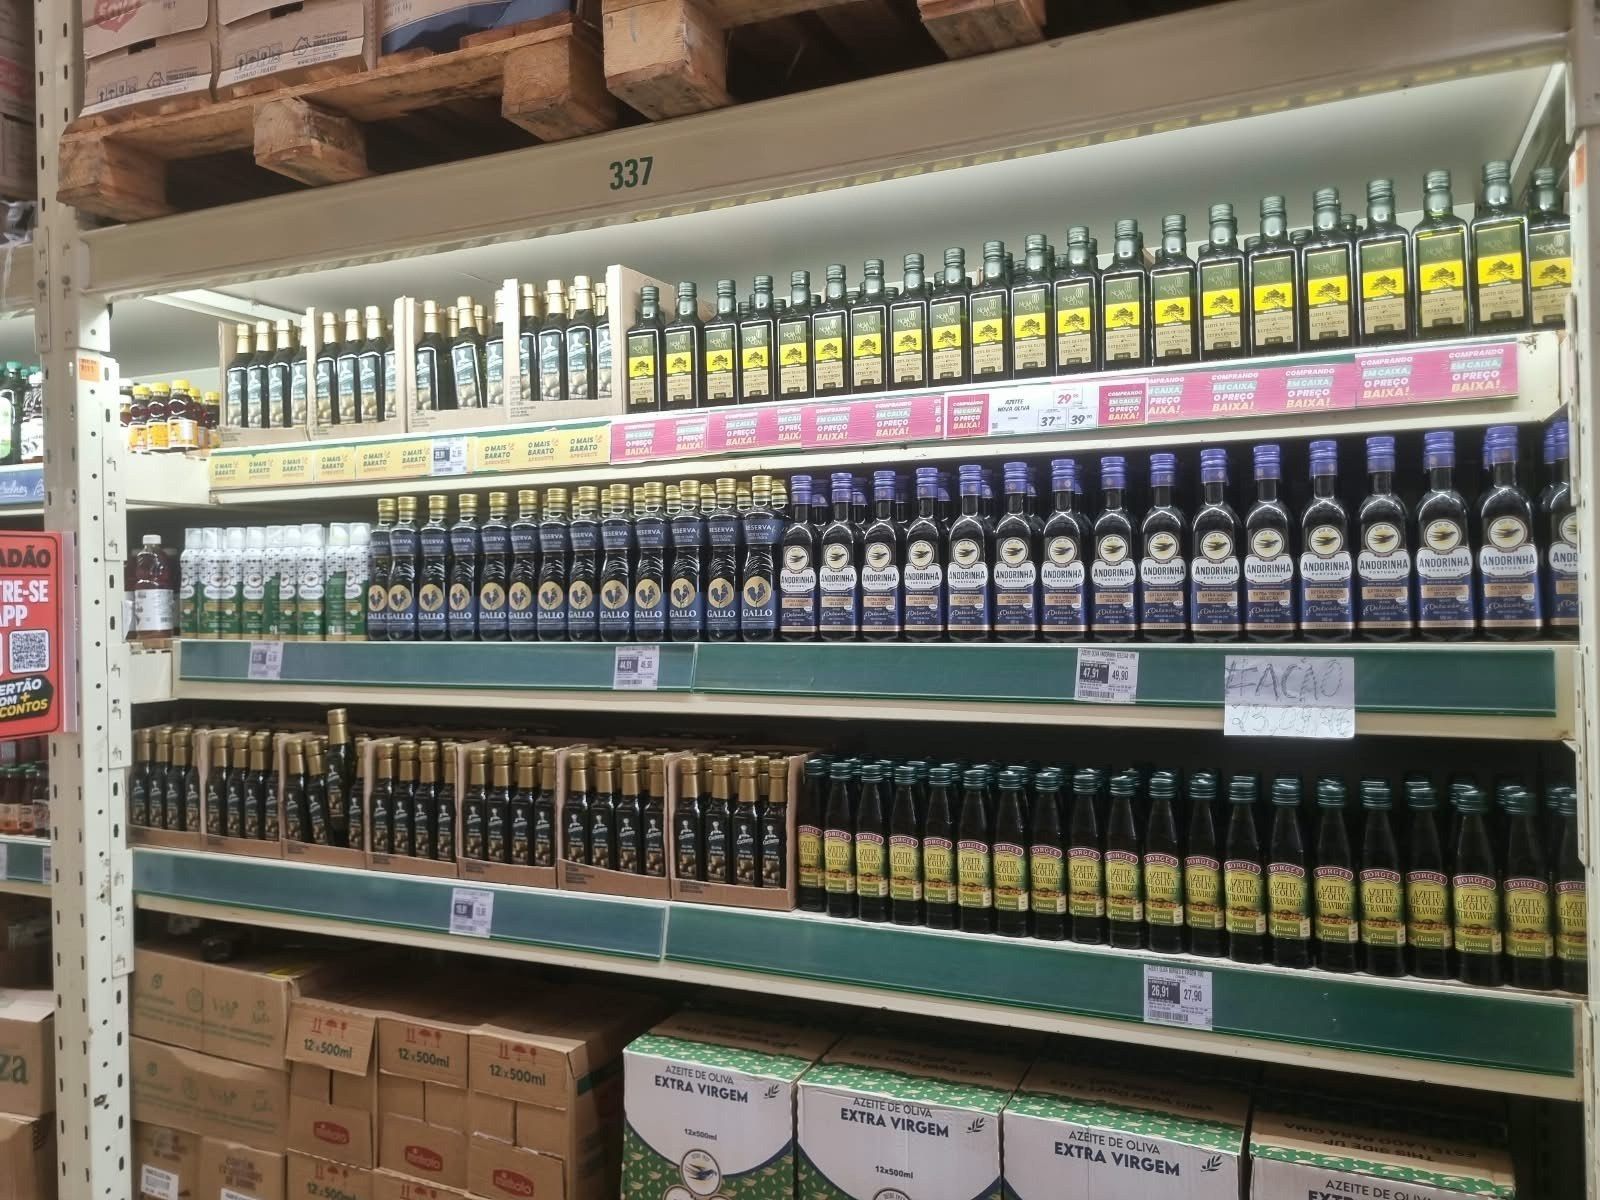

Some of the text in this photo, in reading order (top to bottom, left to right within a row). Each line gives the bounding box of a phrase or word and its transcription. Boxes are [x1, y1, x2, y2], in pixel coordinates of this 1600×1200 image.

[610, 156, 653, 190] 337
[1463, 371, 1500, 381] PREÇO
[1364, 378, 1409, 388] O PREÇO
[1452, 380, 1500, 393] BAIXA!
[1296, 388, 1330, 398] PREÇO
[1363, 387, 1410, 398] BAIXA!
[1056, 394, 1072, 405] 29
[1286, 398, 1330, 408] BAIXA!
[1071, 414, 1085, 425] 39
[1108, 412, 1140, 420] BAIXA!
[1040, 416, 1054, 427] 37
[876, 427, 909, 436] BAIXA!
[528, 448, 554, 456] BARATO
[570, 444, 598, 452] BARATO
[485, 452, 511, 460] BARATO
[1360, 558, 1408, 569] ANDORINHA
[1419, 558, 1470, 568] ANDORINHA
[1482, 554, 1535, 565] ANDORINHA
[1194, 565, 1238, 575] ANDORINHA
[1246, 563, 1292, 573] ANDORINHA
[1303, 560, 1350, 571] ANDORINHA
[996, 570, 1034, 579] ANDORINHA
[1044, 569, 1082, 578] ANDORINHA
[1094, 568, 1134, 578] ANDORINHA
[1143, 566, 1185, 576] ANDORINHA
[387, 612, 414, 620] GALLO
[418, 612, 445, 620] GALLO
[449, 612, 472, 620] GALLO
[480, 612, 506, 620] GALLO
[508, 612, 533, 620] GALLO
[538, 612, 564, 620] GALLO
[568, 610, 594, 618] GALLO
[600, 610, 630, 618] GALLO
[634, 610, 662, 618] GALLO
[670, 609, 697, 618] GALLO
[707, 609, 736, 618] GALLO
[742, 608, 773, 618] GALLO
[1106, 853, 1134, 862] BORGES
[1146, 856, 1173, 864] BORGES
[1186, 858, 1215, 868] BORGES
[1228, 862, 1256, 872] BORGES
[1270, 866, 1300, 875] BORGES
[1318, 869, 1349, 878] BORGES
[1364, 870, 1397, 881] BORGES
[1410, 874, 1443, 883] BORGES
[1456, 878, 1492, 887] BORGES
[1321, 885, 1346, 893] AZEITE
[1508, 882, 1544, 892] BORGES
[1414, 890, 1441, 898] AZEITE
[1462, 894, 1489, 904] AZEITE
[1513, 898, 1542, 906] AZEITE
[1152, 984, 1169, 998] 26,91
[1184, 988, 1202, 1002] 27,90
[666, 1065, 734, 1086] AZEITE DE OLIVA
[655, 1075, 748, 1104] EXTRA VIRGEM
[853, 1097, 933, 1118] AZEITE DE OLIVA
[841, 1107, 950, 1138] EXTRA VIRGEM
[684, 1128, 718, 1142] 12x500ml
[1069, 1130, 1161, 1156] AZEITE DE OLIVA
[1054, 1141, 1180, 1176] EXTRA VIRGEM
[875, 1164, 914, 1179] 12x500ml
[1326, 1180, 1369, 1196] AZEITE
[1373, 1188, 1390, 1199] DE
